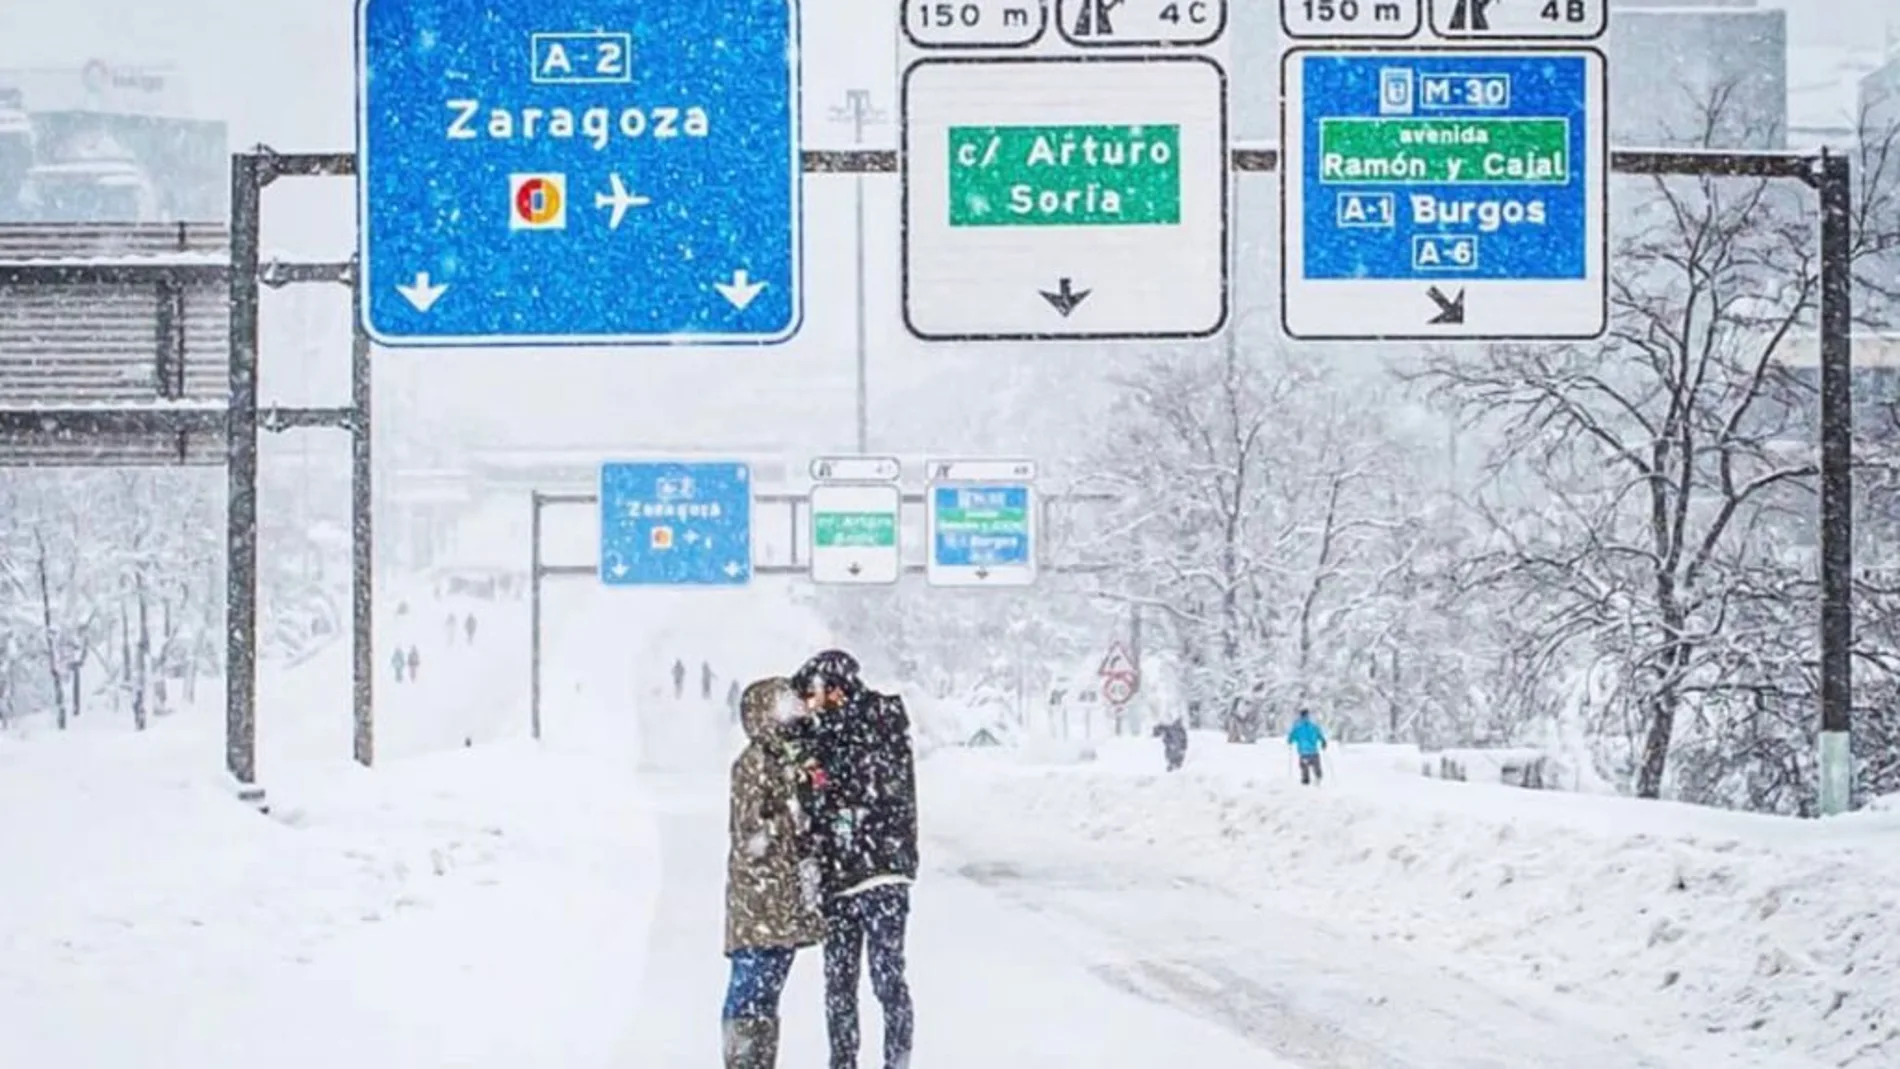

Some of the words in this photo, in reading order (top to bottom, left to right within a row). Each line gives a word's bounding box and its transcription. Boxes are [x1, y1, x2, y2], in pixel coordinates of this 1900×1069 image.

[920, 5, 980, 27] 150
[1004, 9, 1028, 26] m
[1159, 2, 1208, 25] 4C
[1304, 0, 1359, 21] 150
[1375, 3, 1401, 21] m
[1541, 2, 1586, 22] 4B
[541, 43, 623, 74] A-2
[1424, 81, 1506, 105] M-30
[446, 99, 709, 150] Zaragoza
[1399, 126, 1489, 145] avenida
[957, 137, 1001, 167] c/
[1027, 135, 1171, 166] Arturo
[1324, 153, 1426, 177] Ramón
[1447, 157, 1464, 182] y
[1483, 152, 1565, 181] Cajal
[1010, 185, 1122, 214] Soria
[1342, 198, 1391, 222] A-1
[1411, 194, 1546, 231] Burgos
[1418, 241, 1473, 265] A-6
